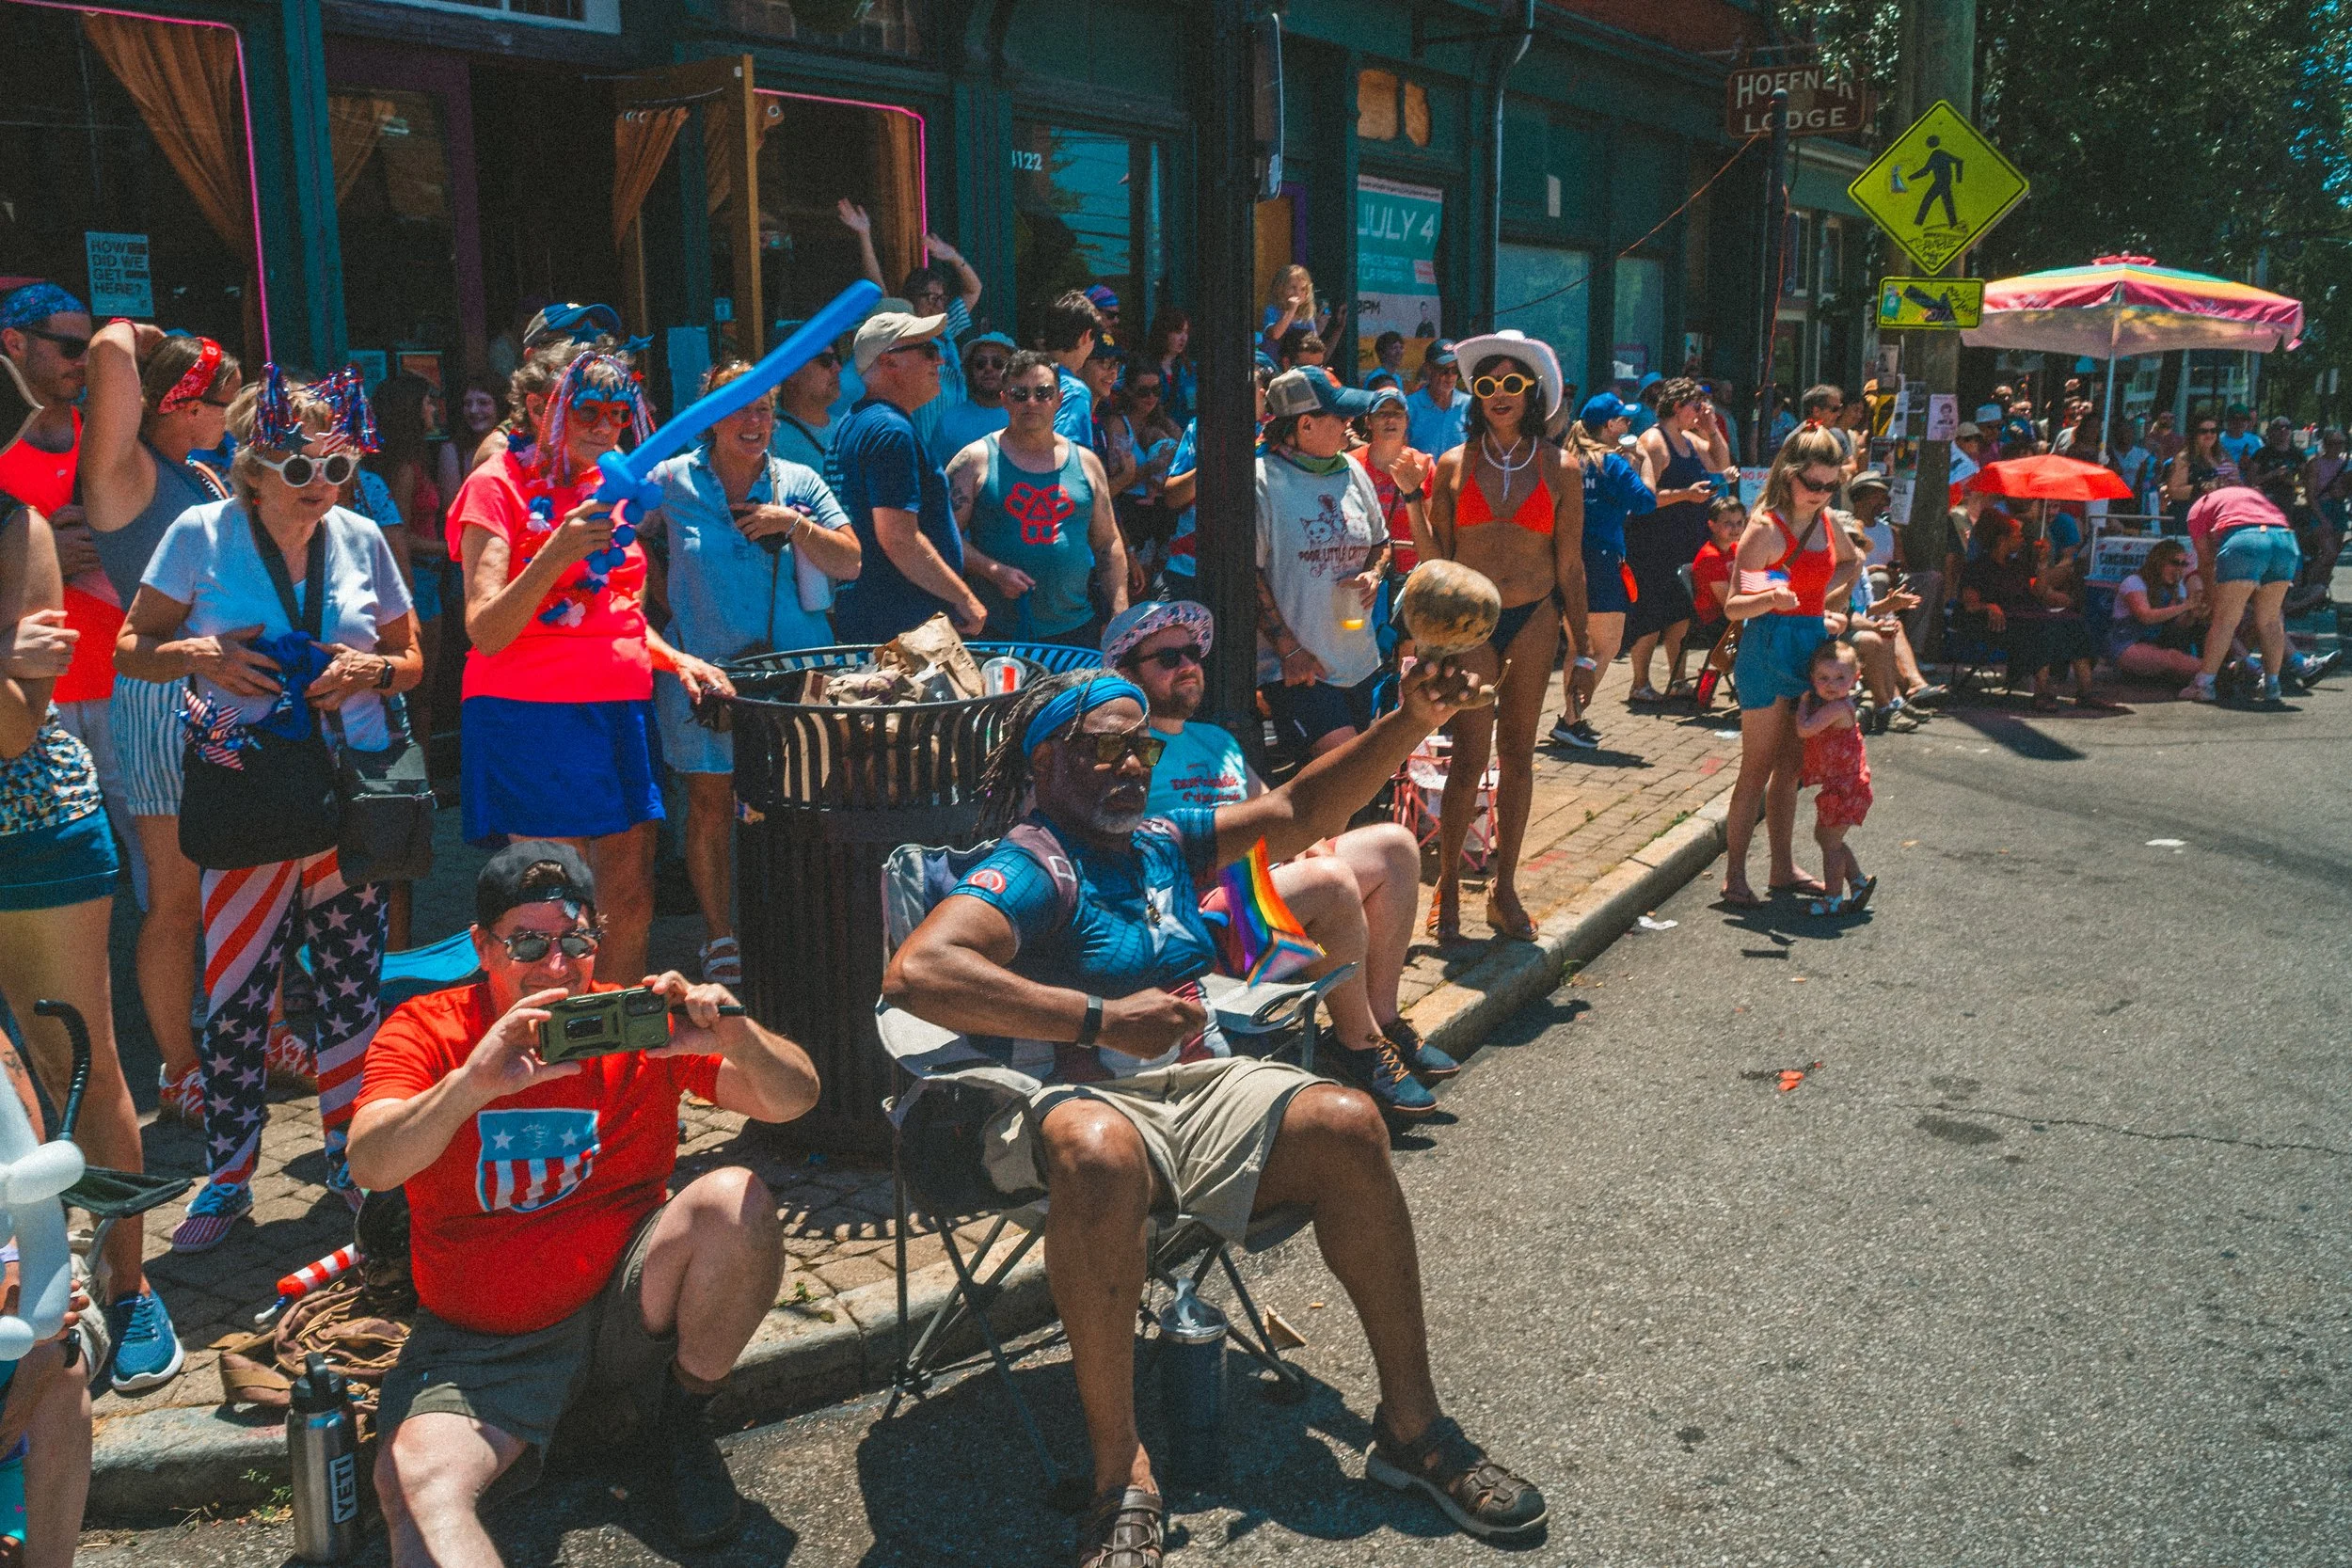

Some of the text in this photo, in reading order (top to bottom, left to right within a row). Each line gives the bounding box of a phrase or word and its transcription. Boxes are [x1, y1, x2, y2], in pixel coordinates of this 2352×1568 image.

[1358, 203, 1435, 244] JULY 4
[91, 240, 124, 252] HOW
[92, 254, 144, 269] DID WE
[94, 268, 121, 280] GET
[94, 282, 142, 294] HERE?
[1322, 546, 1346, 562] LITTLE
[335, 1459, 355, 1519] YETI
